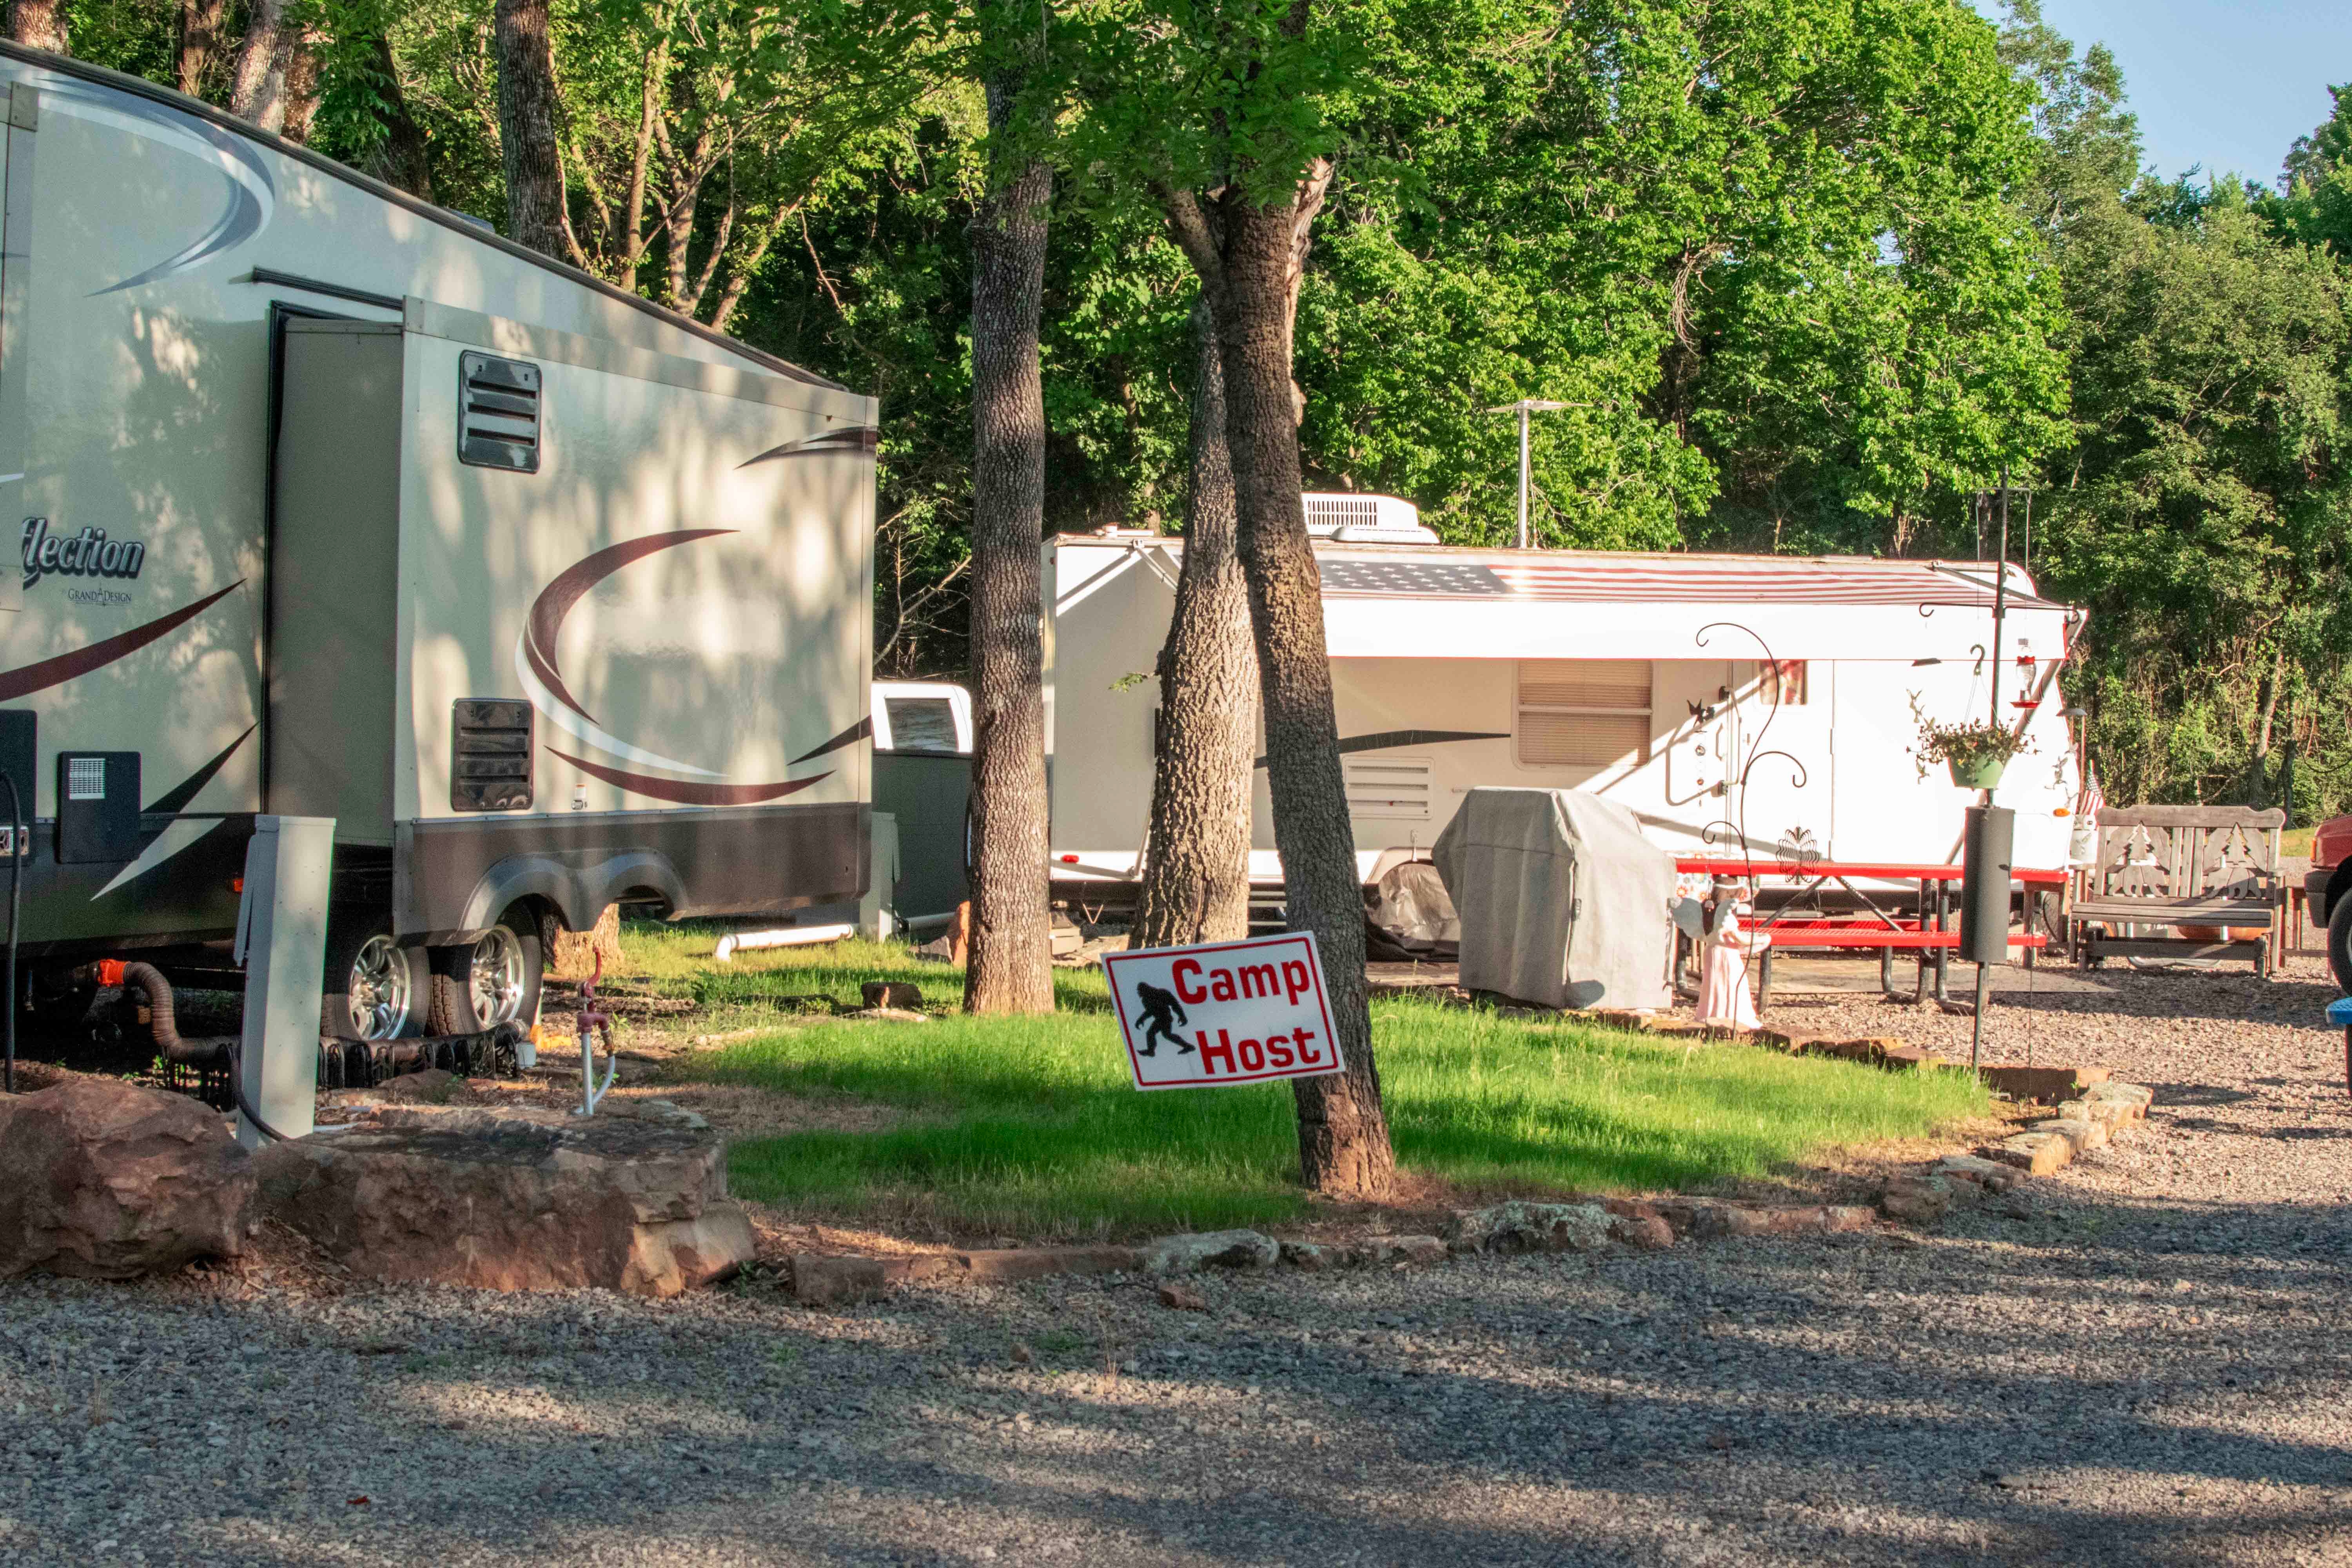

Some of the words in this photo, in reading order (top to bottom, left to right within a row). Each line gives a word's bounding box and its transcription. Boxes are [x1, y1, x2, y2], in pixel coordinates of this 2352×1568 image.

[68, 588, 98, 601] GRAND
[103, 590, 132, 603] DESIGN
[1172, 958, 1310, 1006] Camp
[1196, 1027, 1320, 1075] Host
